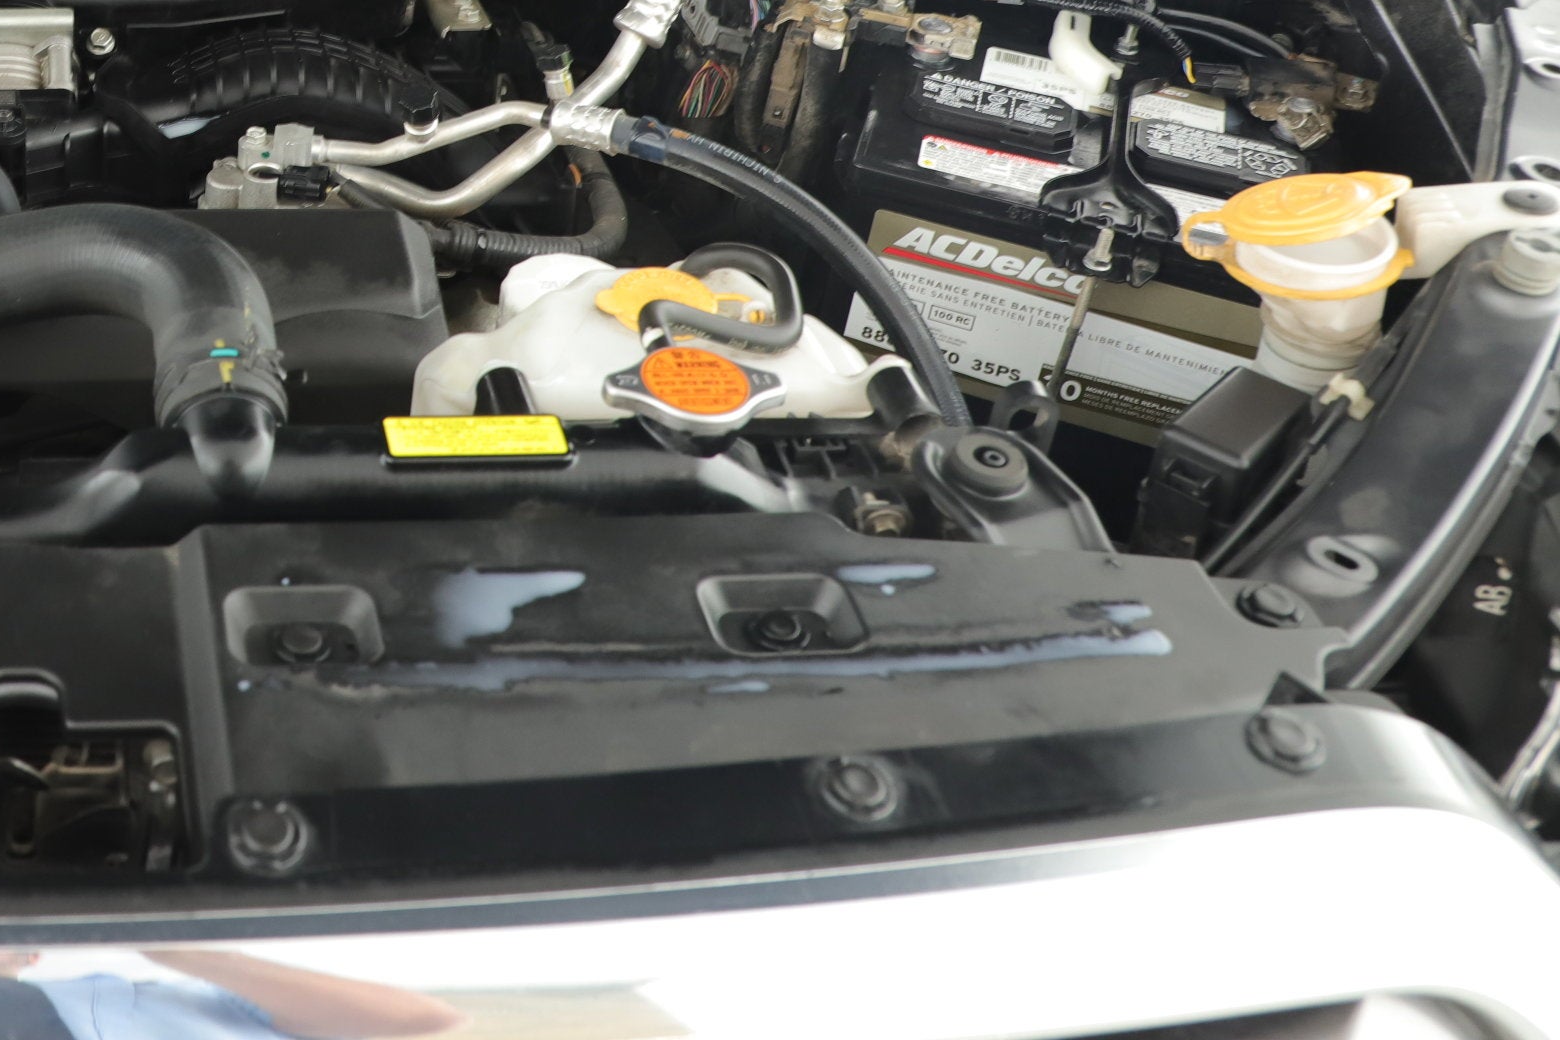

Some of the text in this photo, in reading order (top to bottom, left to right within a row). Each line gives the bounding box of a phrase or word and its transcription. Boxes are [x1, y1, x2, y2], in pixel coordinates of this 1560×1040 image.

[1007, 87, 1056, 105] POISON
[890, 268, 1070, 323] AINTENANCE FREE BATTERY
[929, 289, 959, 304] SANS
[963, 298, 1026, 322] ENTRETIEN
[1088, 332, 1121, 349] LIBRE
[1126, 343, 1141, 354] DE
[933, 309, 970, 326] 100 RC
[971, 359, 1021, 382] 35PS
[1085, 386, 1118, 400] MONTHS
[1119, 394, 1141, 406] FREE
[1472, 585, 1513, 616] AB
